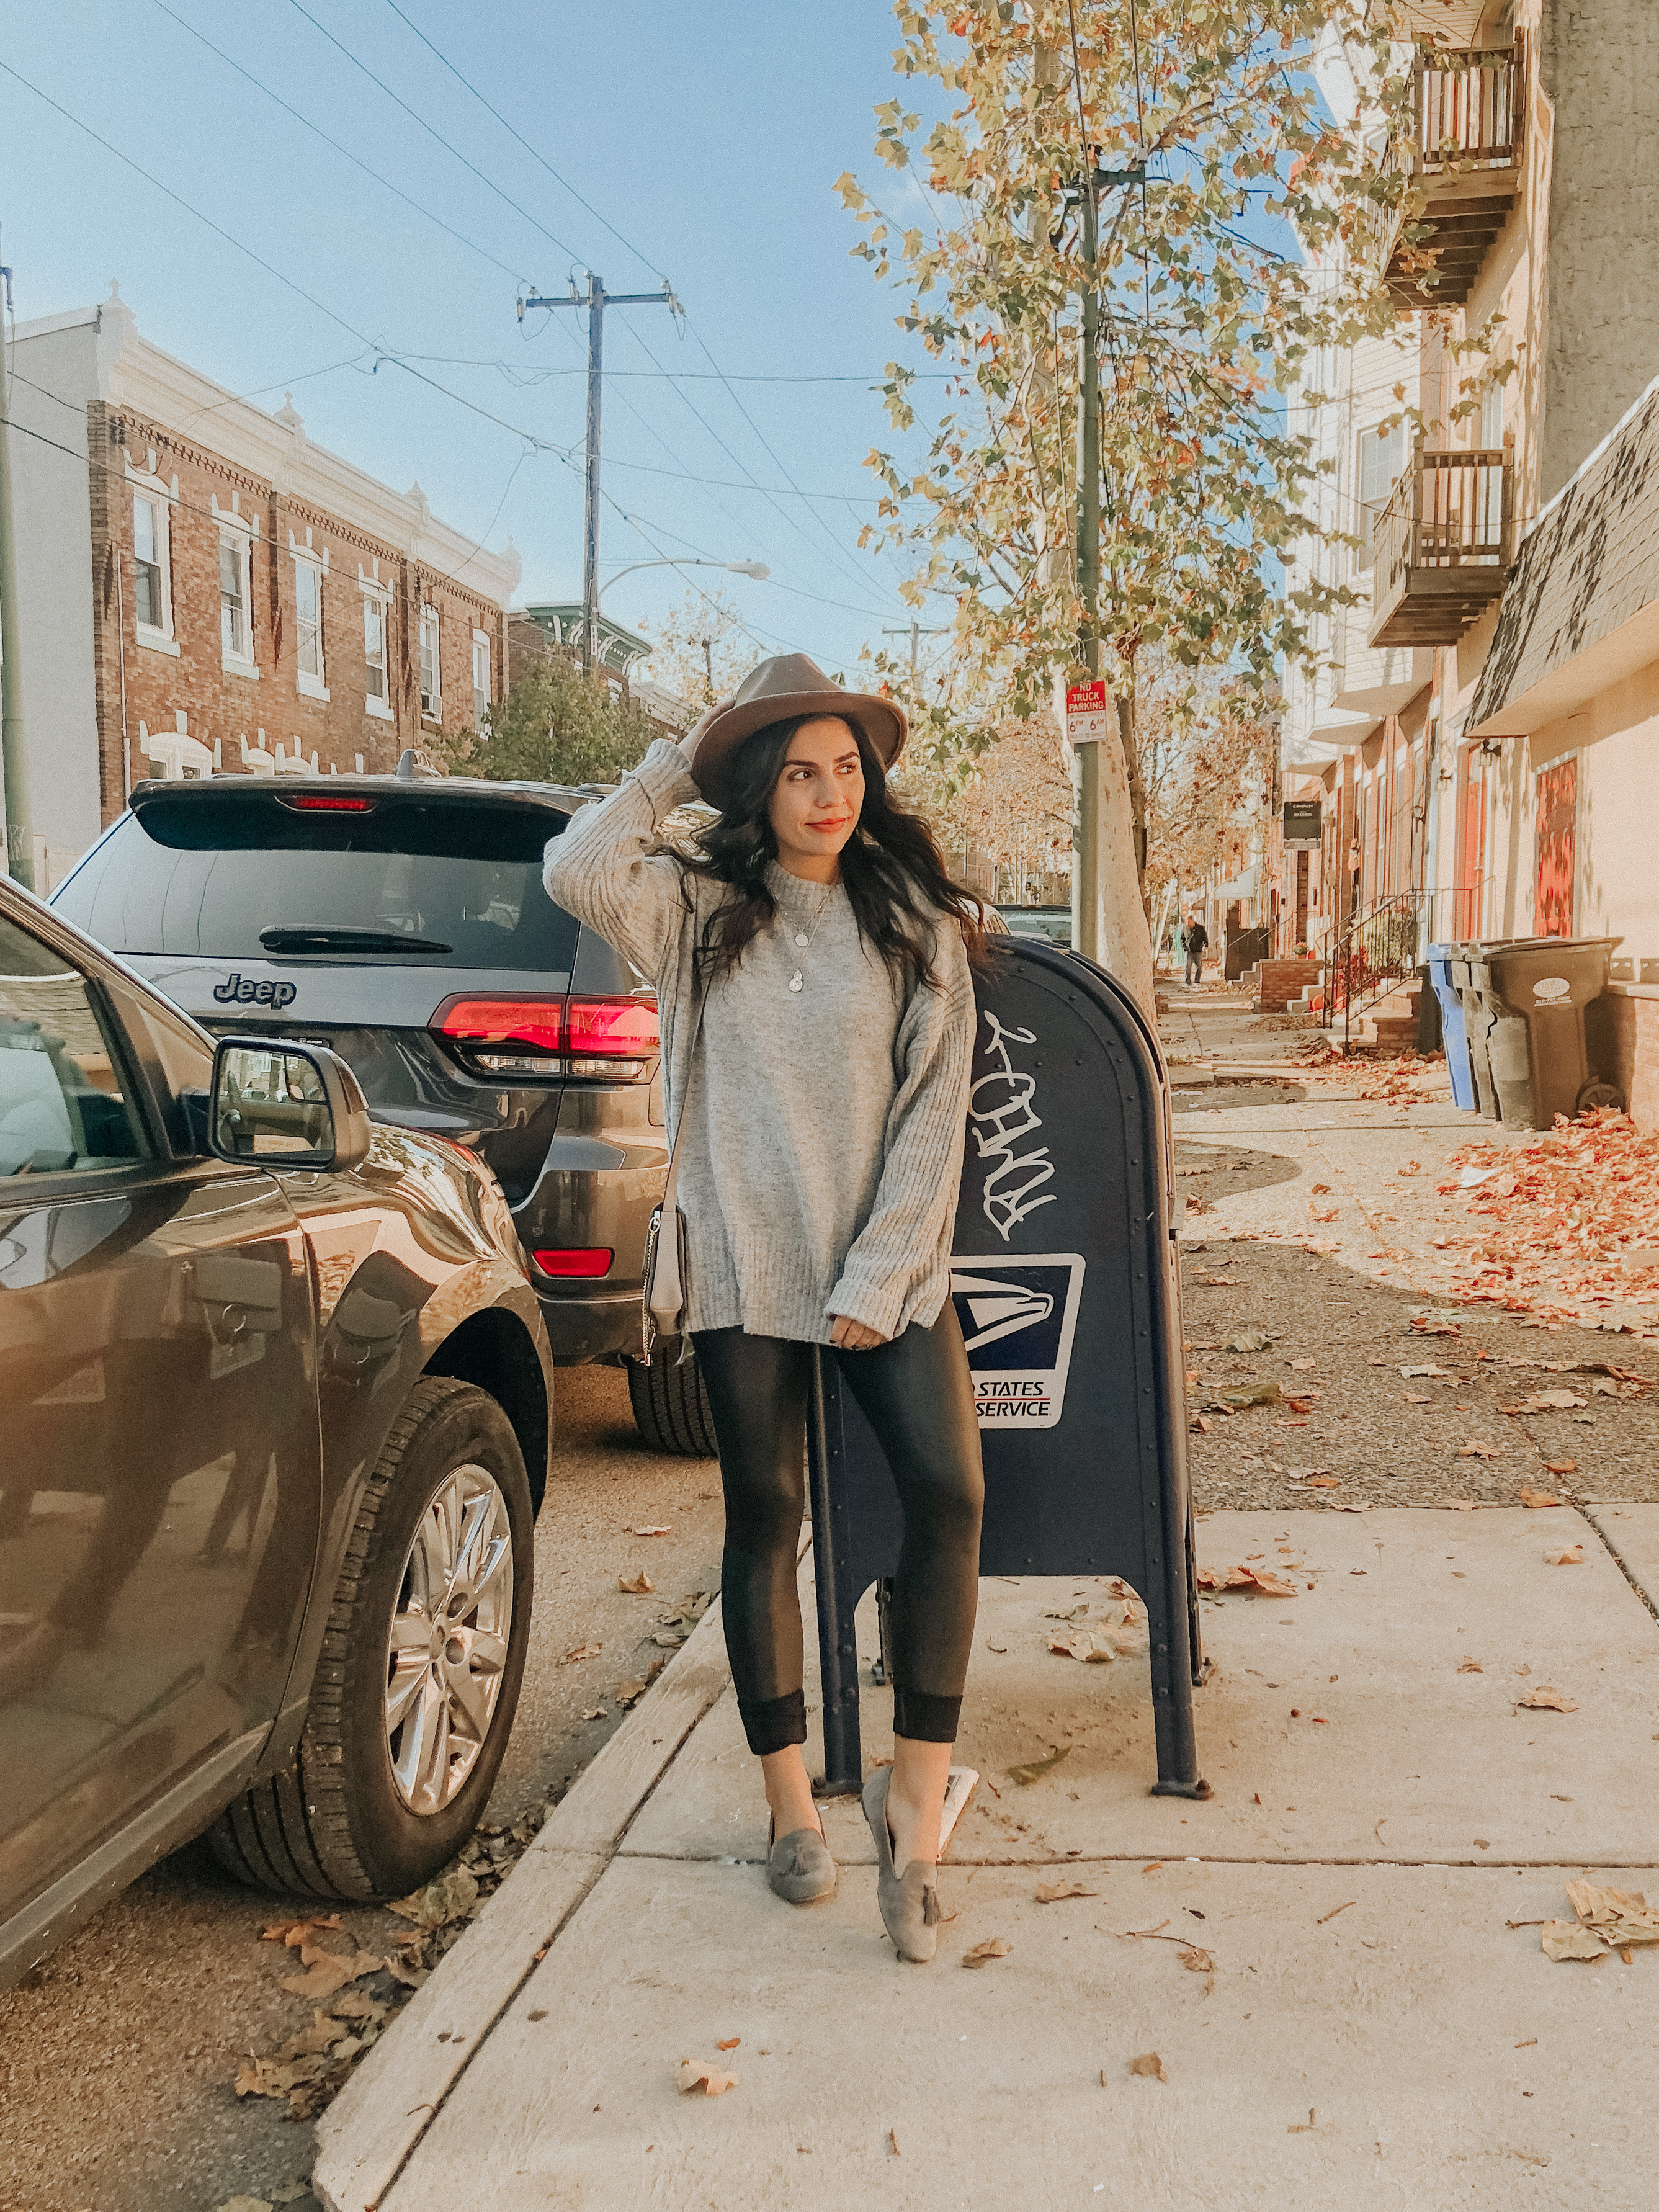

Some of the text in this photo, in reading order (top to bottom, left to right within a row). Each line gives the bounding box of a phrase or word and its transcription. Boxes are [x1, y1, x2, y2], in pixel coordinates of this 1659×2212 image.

[1080, 683, 1091, 692] NO
[1072, 692, 1099, 702] TRUCK
[1068, 701, 1104, 712] PARKING
[213, 973, 297, 1010] Jeep
[978, 1382, 1044, 1396] STATES
[976, 1402, 1050, 1416] SERVICE
